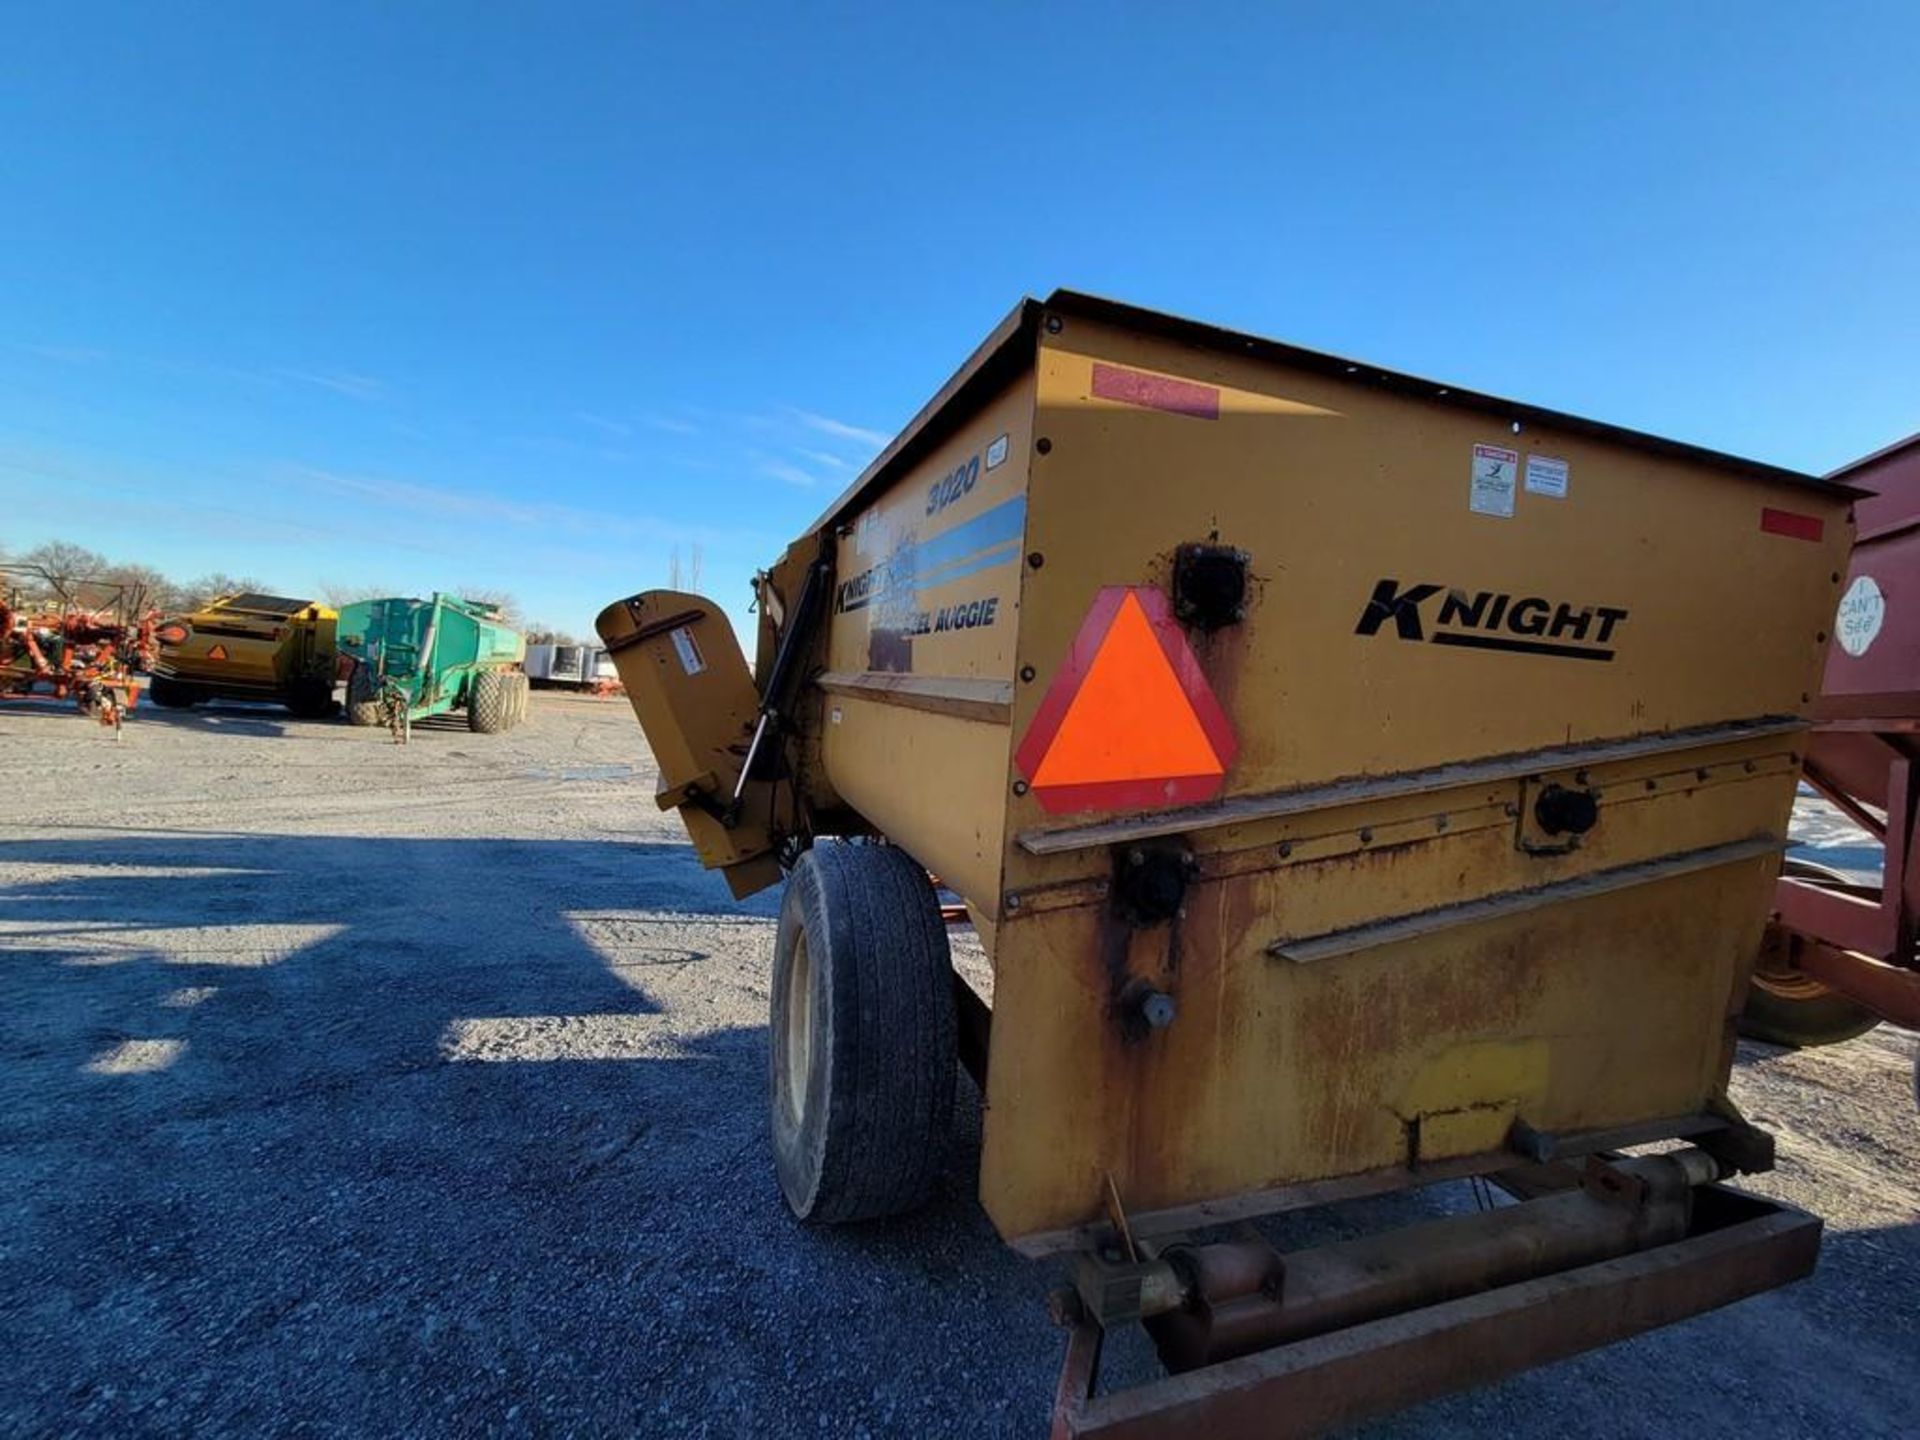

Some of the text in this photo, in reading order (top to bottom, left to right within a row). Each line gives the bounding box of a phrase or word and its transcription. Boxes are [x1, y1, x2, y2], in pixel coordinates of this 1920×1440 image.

[926, 456, 980, 514] 3020
[934, 598, 998, 633] AUGGIE
[1354, 579, 1629, 643] KNIGHT
